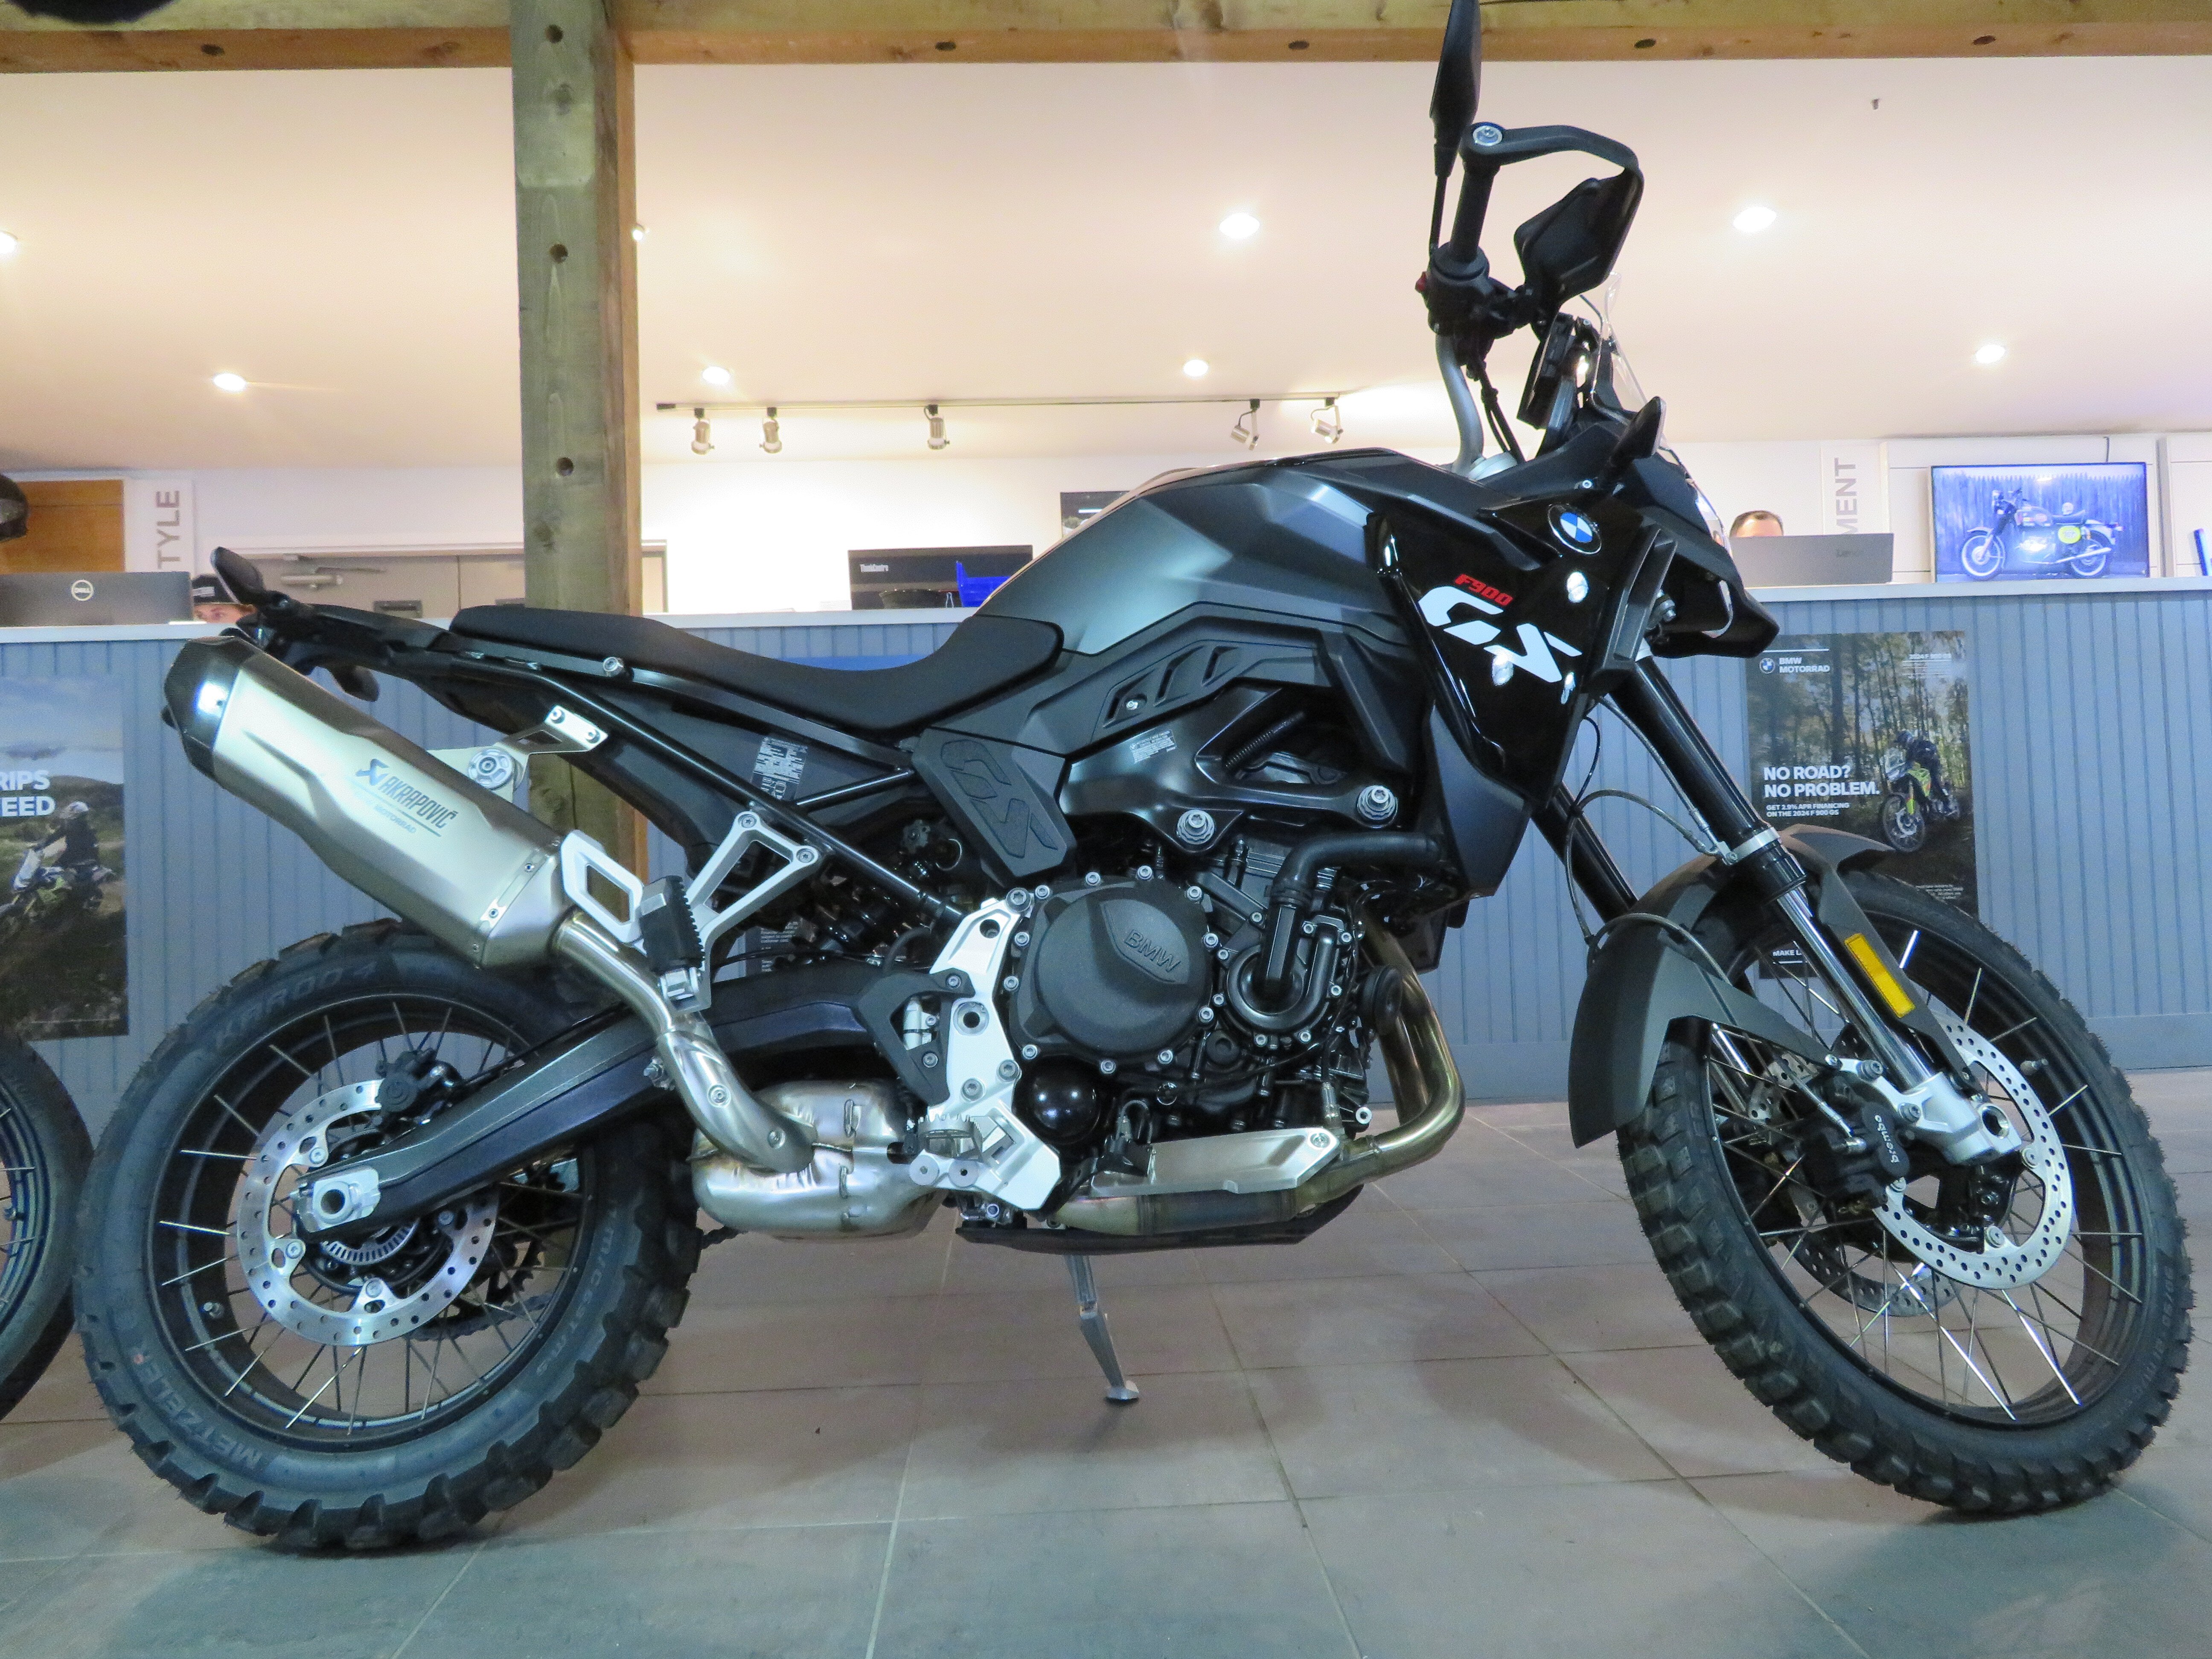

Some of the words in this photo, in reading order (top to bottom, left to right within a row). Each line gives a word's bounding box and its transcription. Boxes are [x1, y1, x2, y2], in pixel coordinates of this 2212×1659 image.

[156, 489, 181, 568] TYLE
[1779, 657, 1802, 665] BMW
[1779, 664, 1831, 673] MOTORRAD
[1764, 767, 1790, 780] NO
[1793, 765, 1851, 780] ROAD?
[1765, 784, 1790, 797] NO
[1793, 781, 1881, 797] PROBLEM.
[0, 796, 56, 817] EED
[1123, 928, 1182, 973] BMW
[1874, 1114, 1900, 1164] brembo
